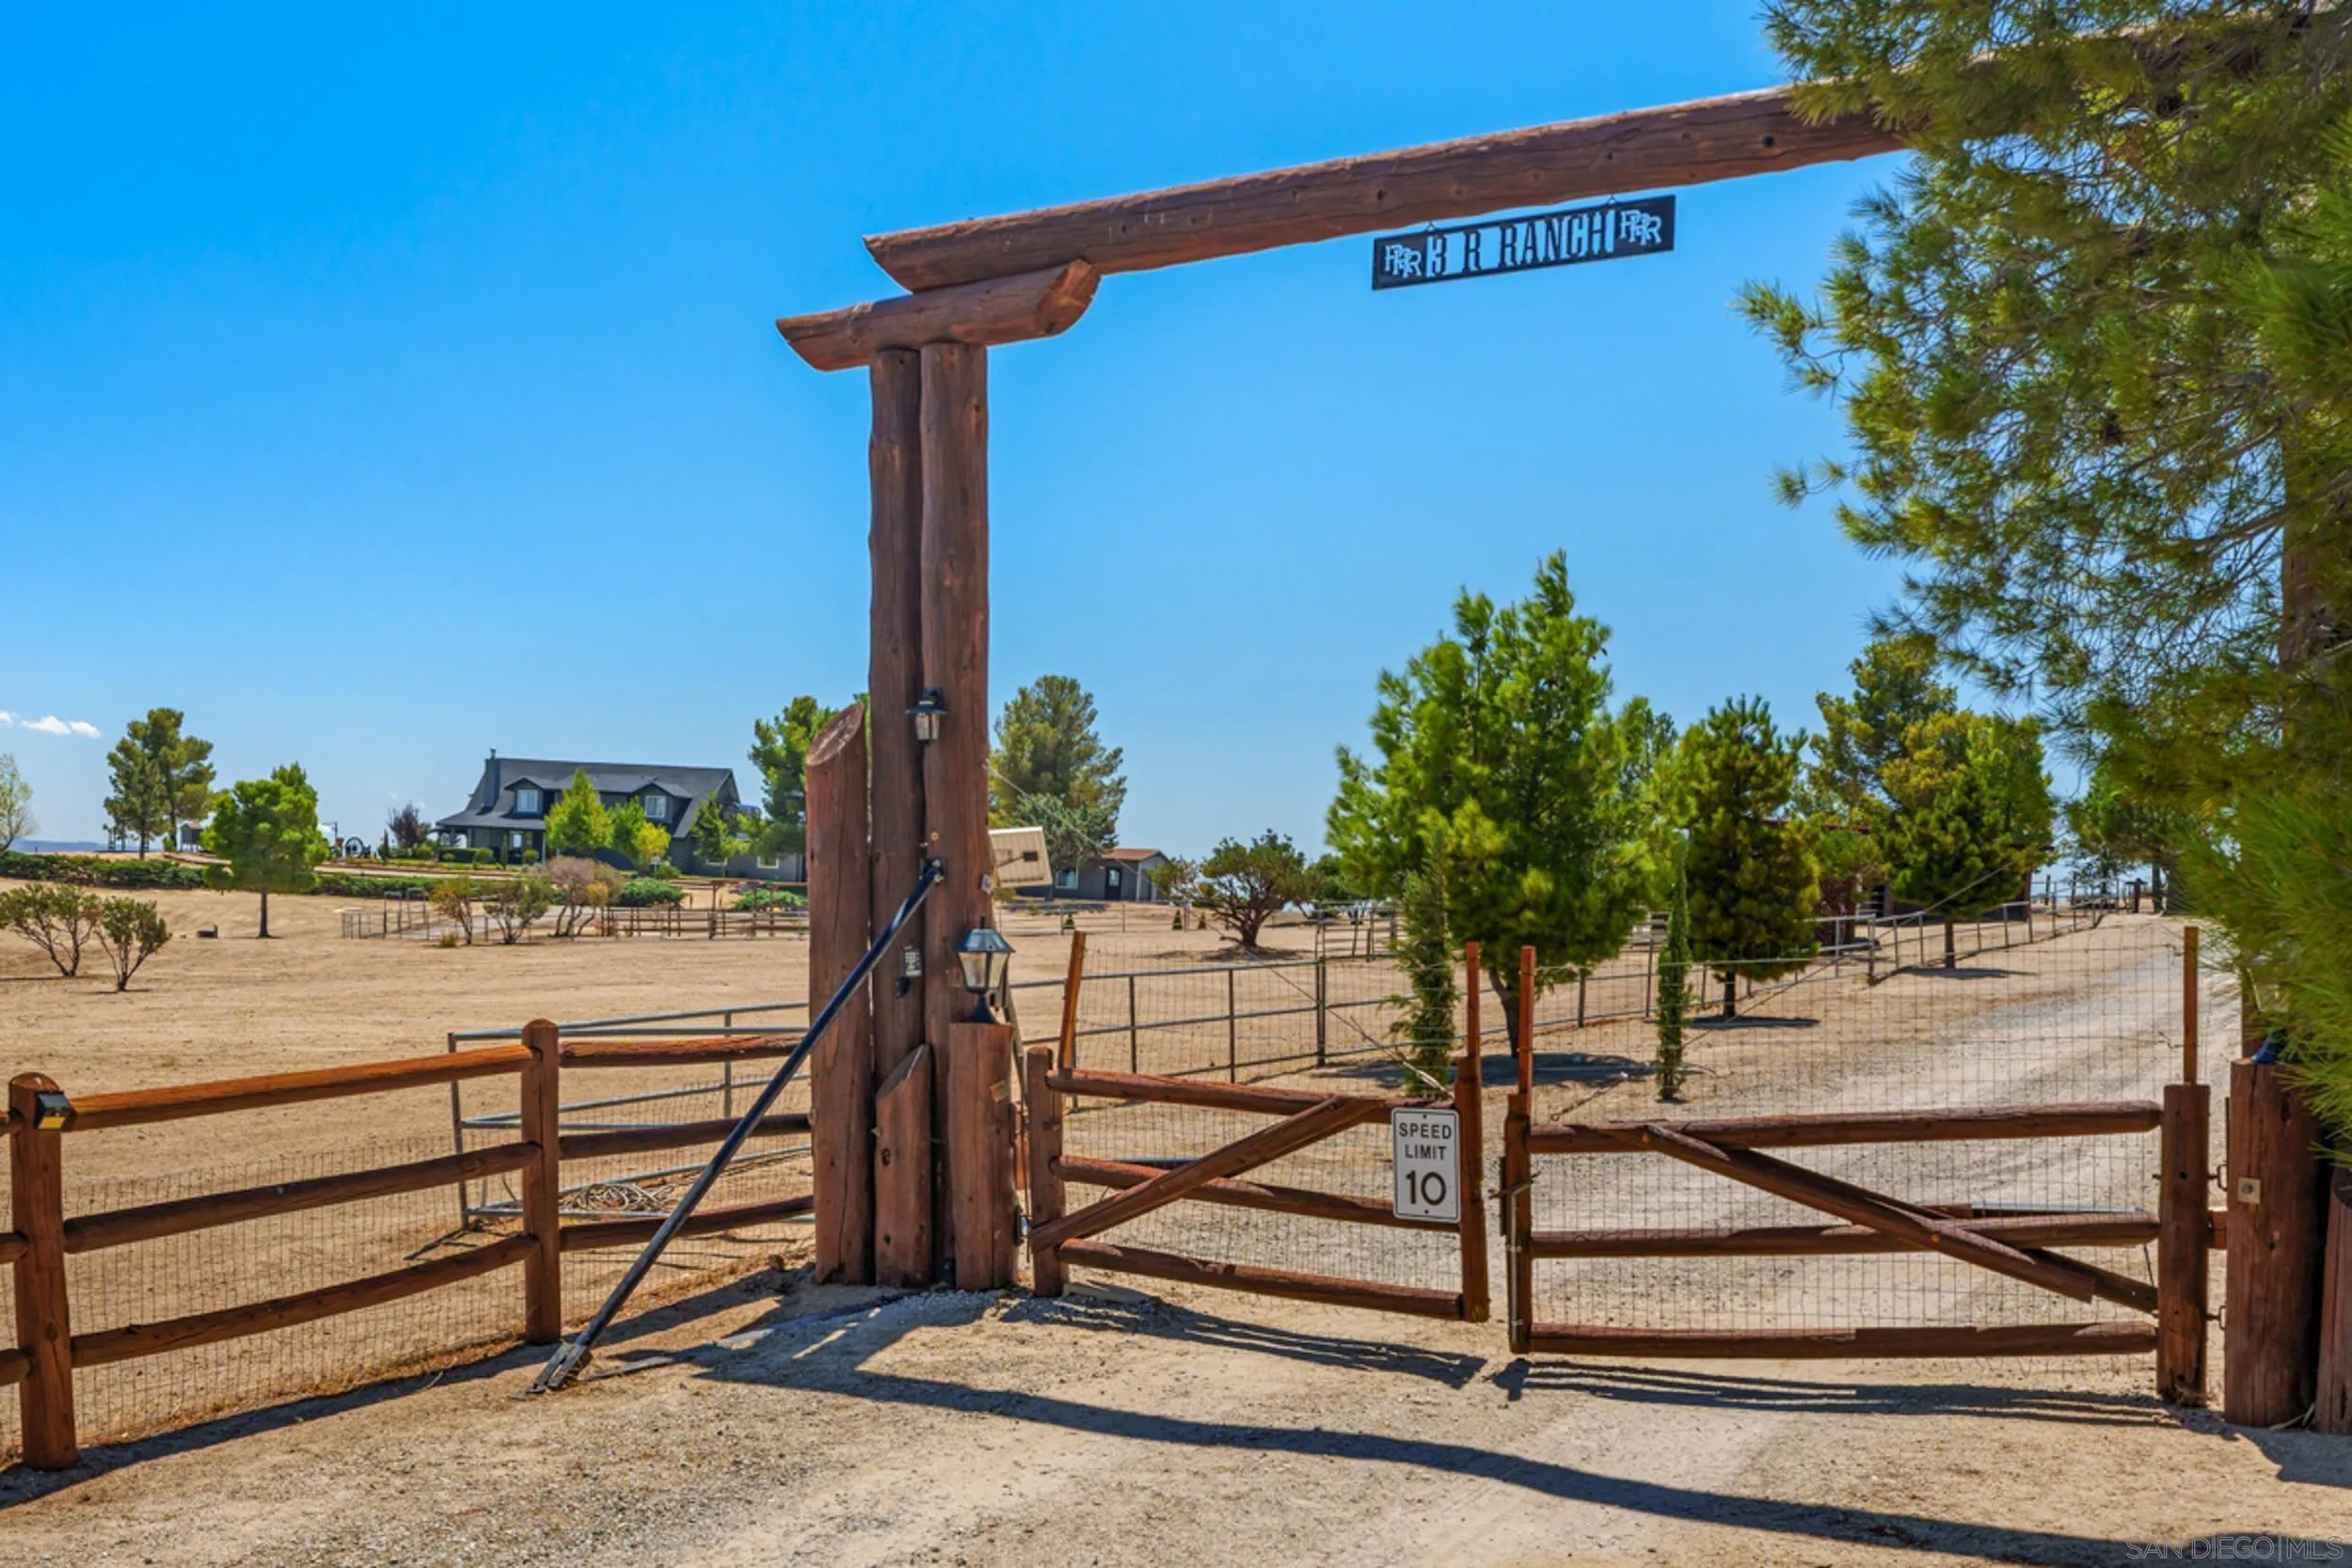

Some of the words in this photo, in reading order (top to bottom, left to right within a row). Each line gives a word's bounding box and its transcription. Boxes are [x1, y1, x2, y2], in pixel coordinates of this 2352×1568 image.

[1462, 230, 1483, 274] R
[1498, 209, 1607, 269] RANCH
[1399, 1122, 1453, 1140] SPEED
[1405, 1144, 1447, 1161] LIMIT
[1406, 1169, 1447, 1207] 10
